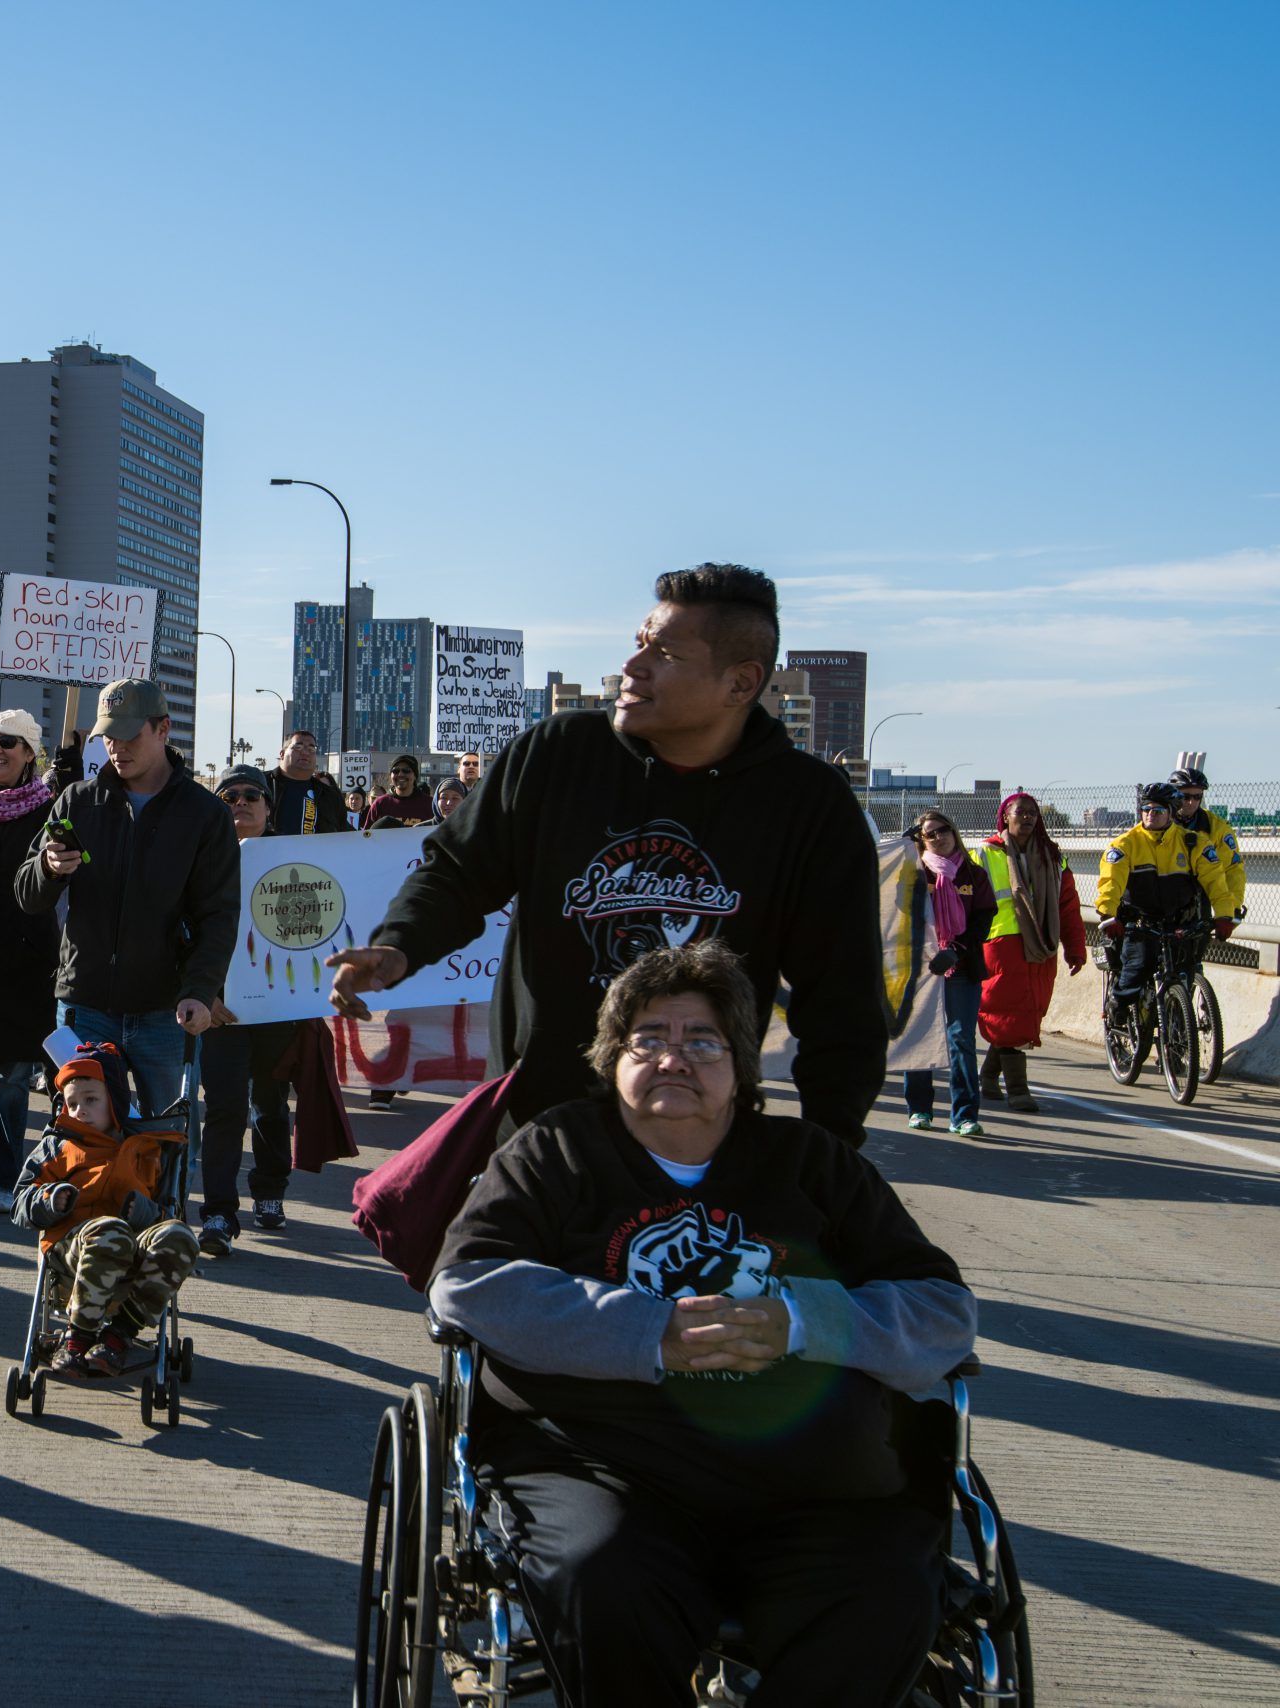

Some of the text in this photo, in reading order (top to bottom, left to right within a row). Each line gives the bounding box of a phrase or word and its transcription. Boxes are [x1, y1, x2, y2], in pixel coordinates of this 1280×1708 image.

[13, 607, 68, 629] noun
[57, 659, 75, 677] it
[436, 654, 511, 680] Dan Snyder
[789, 657, 848, 665] COURTYARD
[472, 684, 480, 697] is
[484, 681, 523, 700] Jewish)
[438, 697, 526, 719] perpetuating RACISM
[437, 716, 461, 734] against
[463, 717, 494, 735] another
[437, 734, 466, 752] affected
[468, 735, 481, 753] by
[345, 775, 367, 787] 30
[259, 878, 332, 896] Minnesota
[562, 863, 741, 919] Southsiders
[261, 900, 335, 920] Two Spirit
[598, 899, 667, 911] MINNEAPOLIS
[275, 922, 323, 941] Society
[445, 954, 500, 981] Soc
